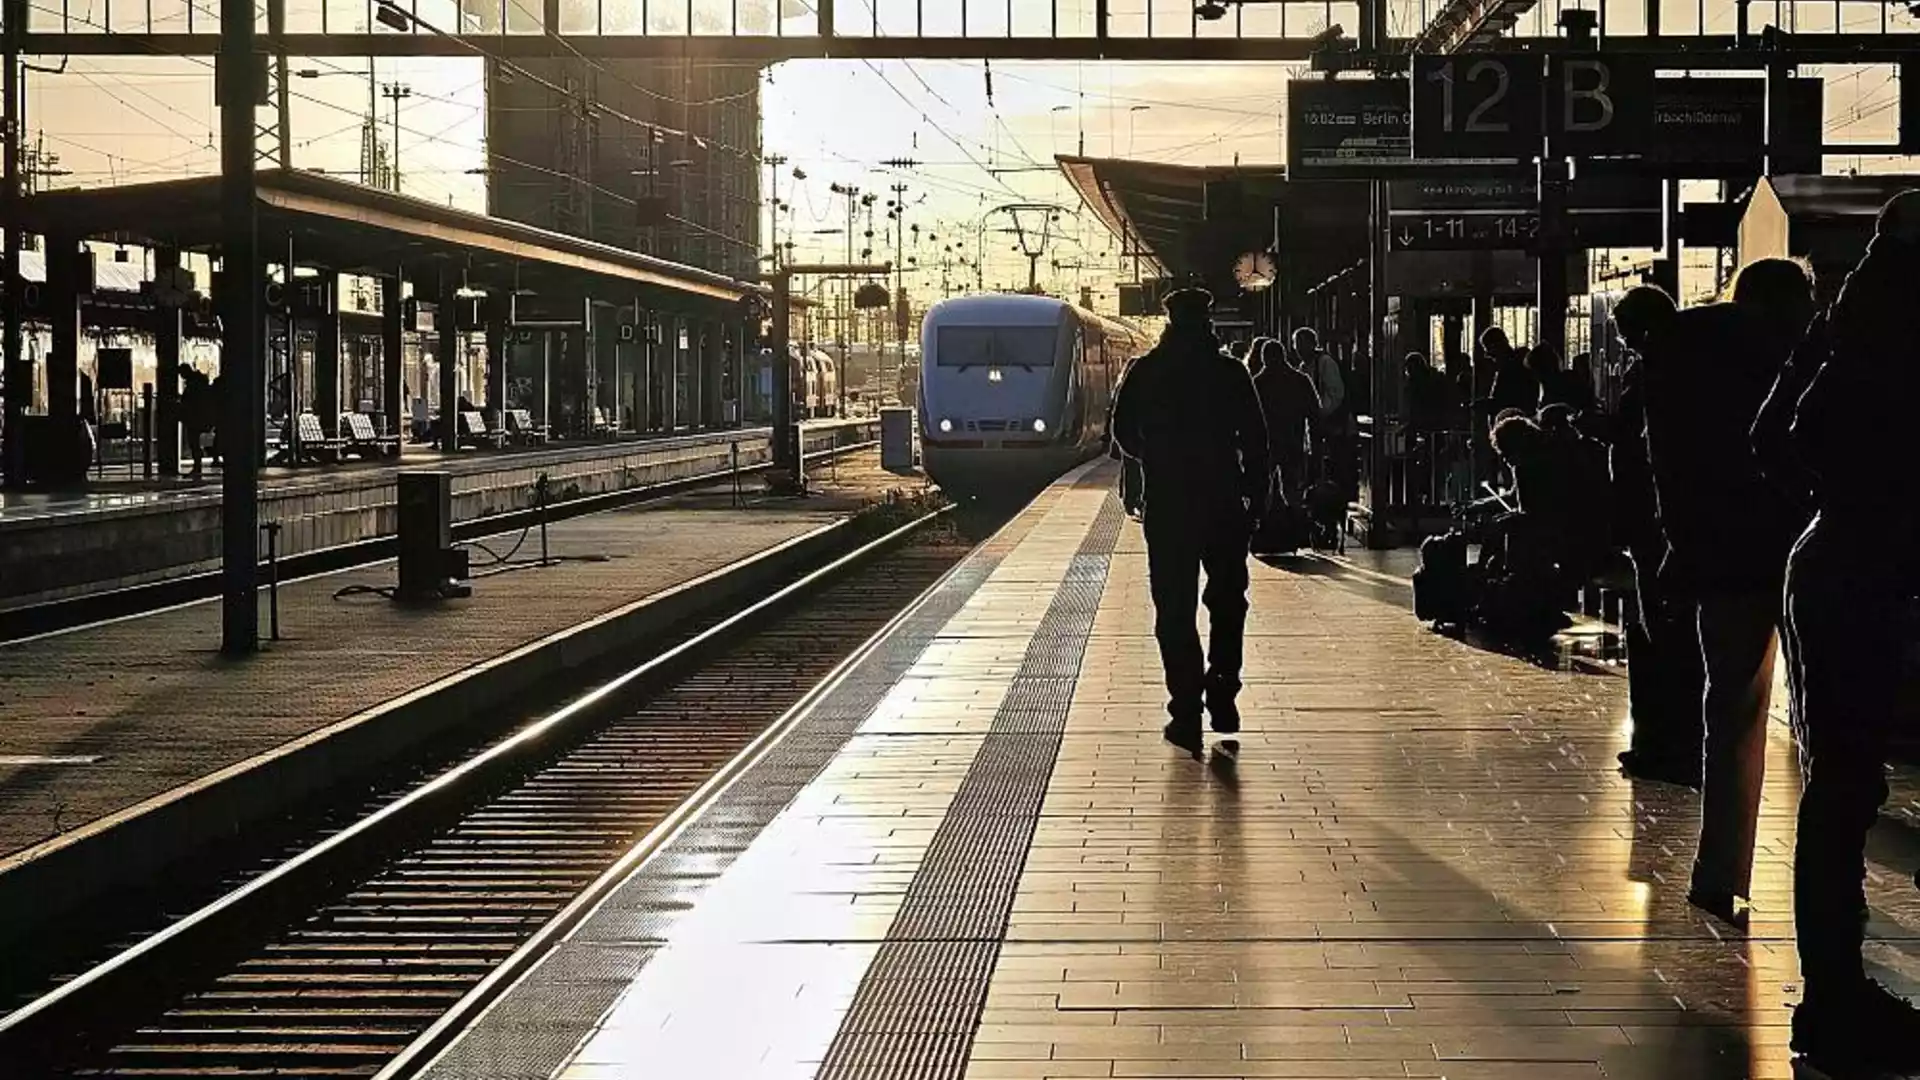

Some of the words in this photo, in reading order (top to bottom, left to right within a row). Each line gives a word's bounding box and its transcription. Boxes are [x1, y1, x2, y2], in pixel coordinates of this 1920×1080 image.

[1426, 61, 1510, 132] 12
[1564, 60, 1615, 132] B
[1363, 111, 1399, 125] Berlin
[1424, 219, 1465, 240] 1-11
[1494, 217, 1540, 239] 14-2
[620, 324, 634, 341] D
